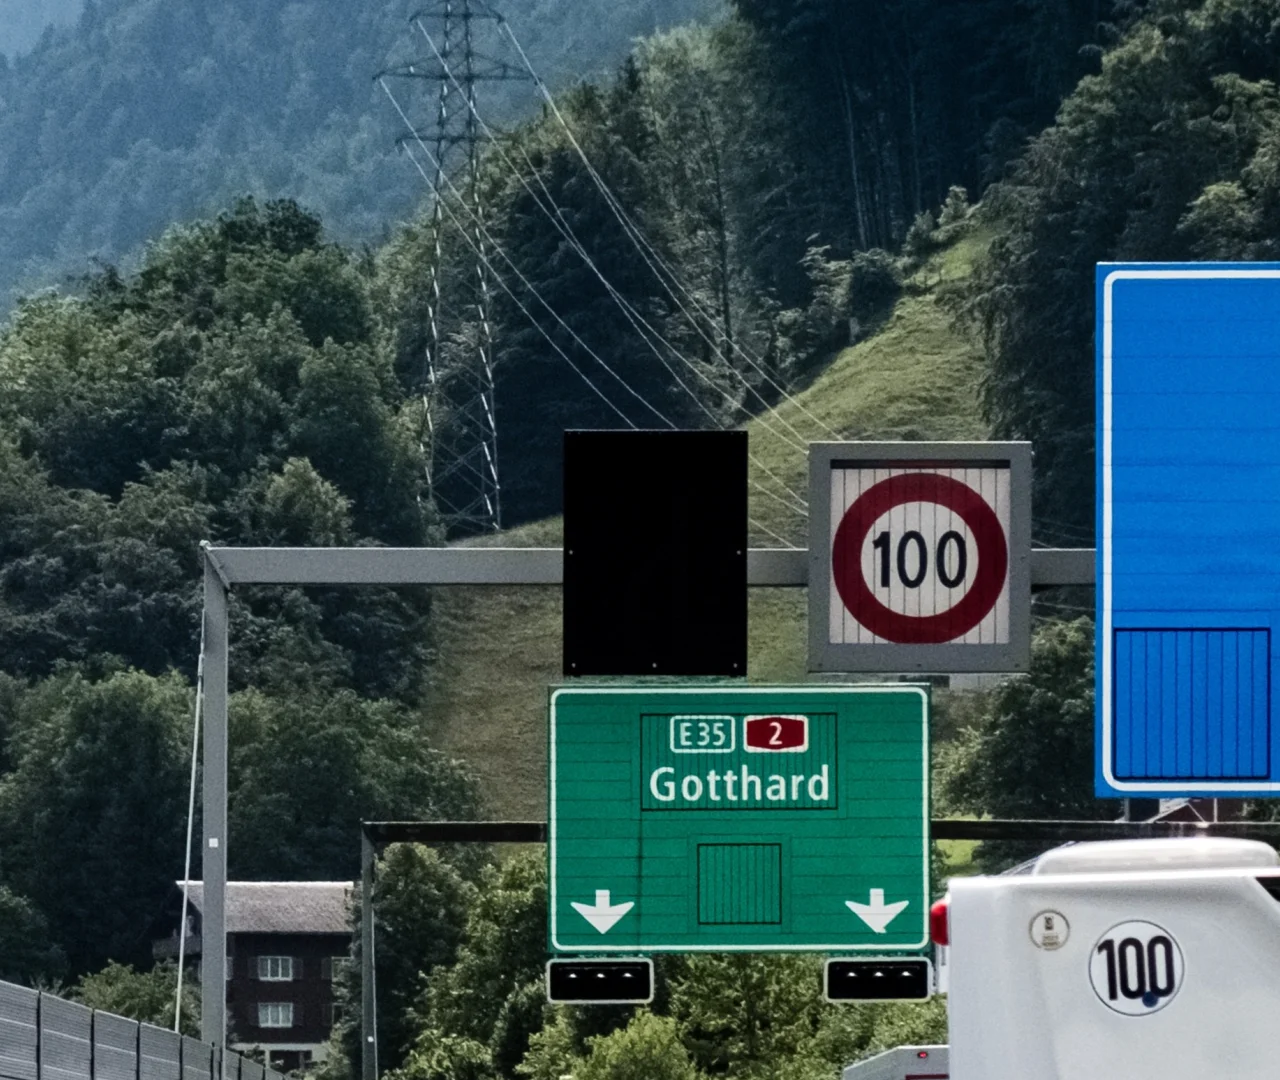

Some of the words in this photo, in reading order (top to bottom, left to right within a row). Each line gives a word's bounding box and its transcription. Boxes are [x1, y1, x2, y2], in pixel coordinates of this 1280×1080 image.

[873, 530, 967, 588] 100
[680, 722, 726, 746] E35
[769, 721, 782, 745] 2
[649, 764, 829, 801] Gotthard
[1097, 935, 1175, 1001] 100
